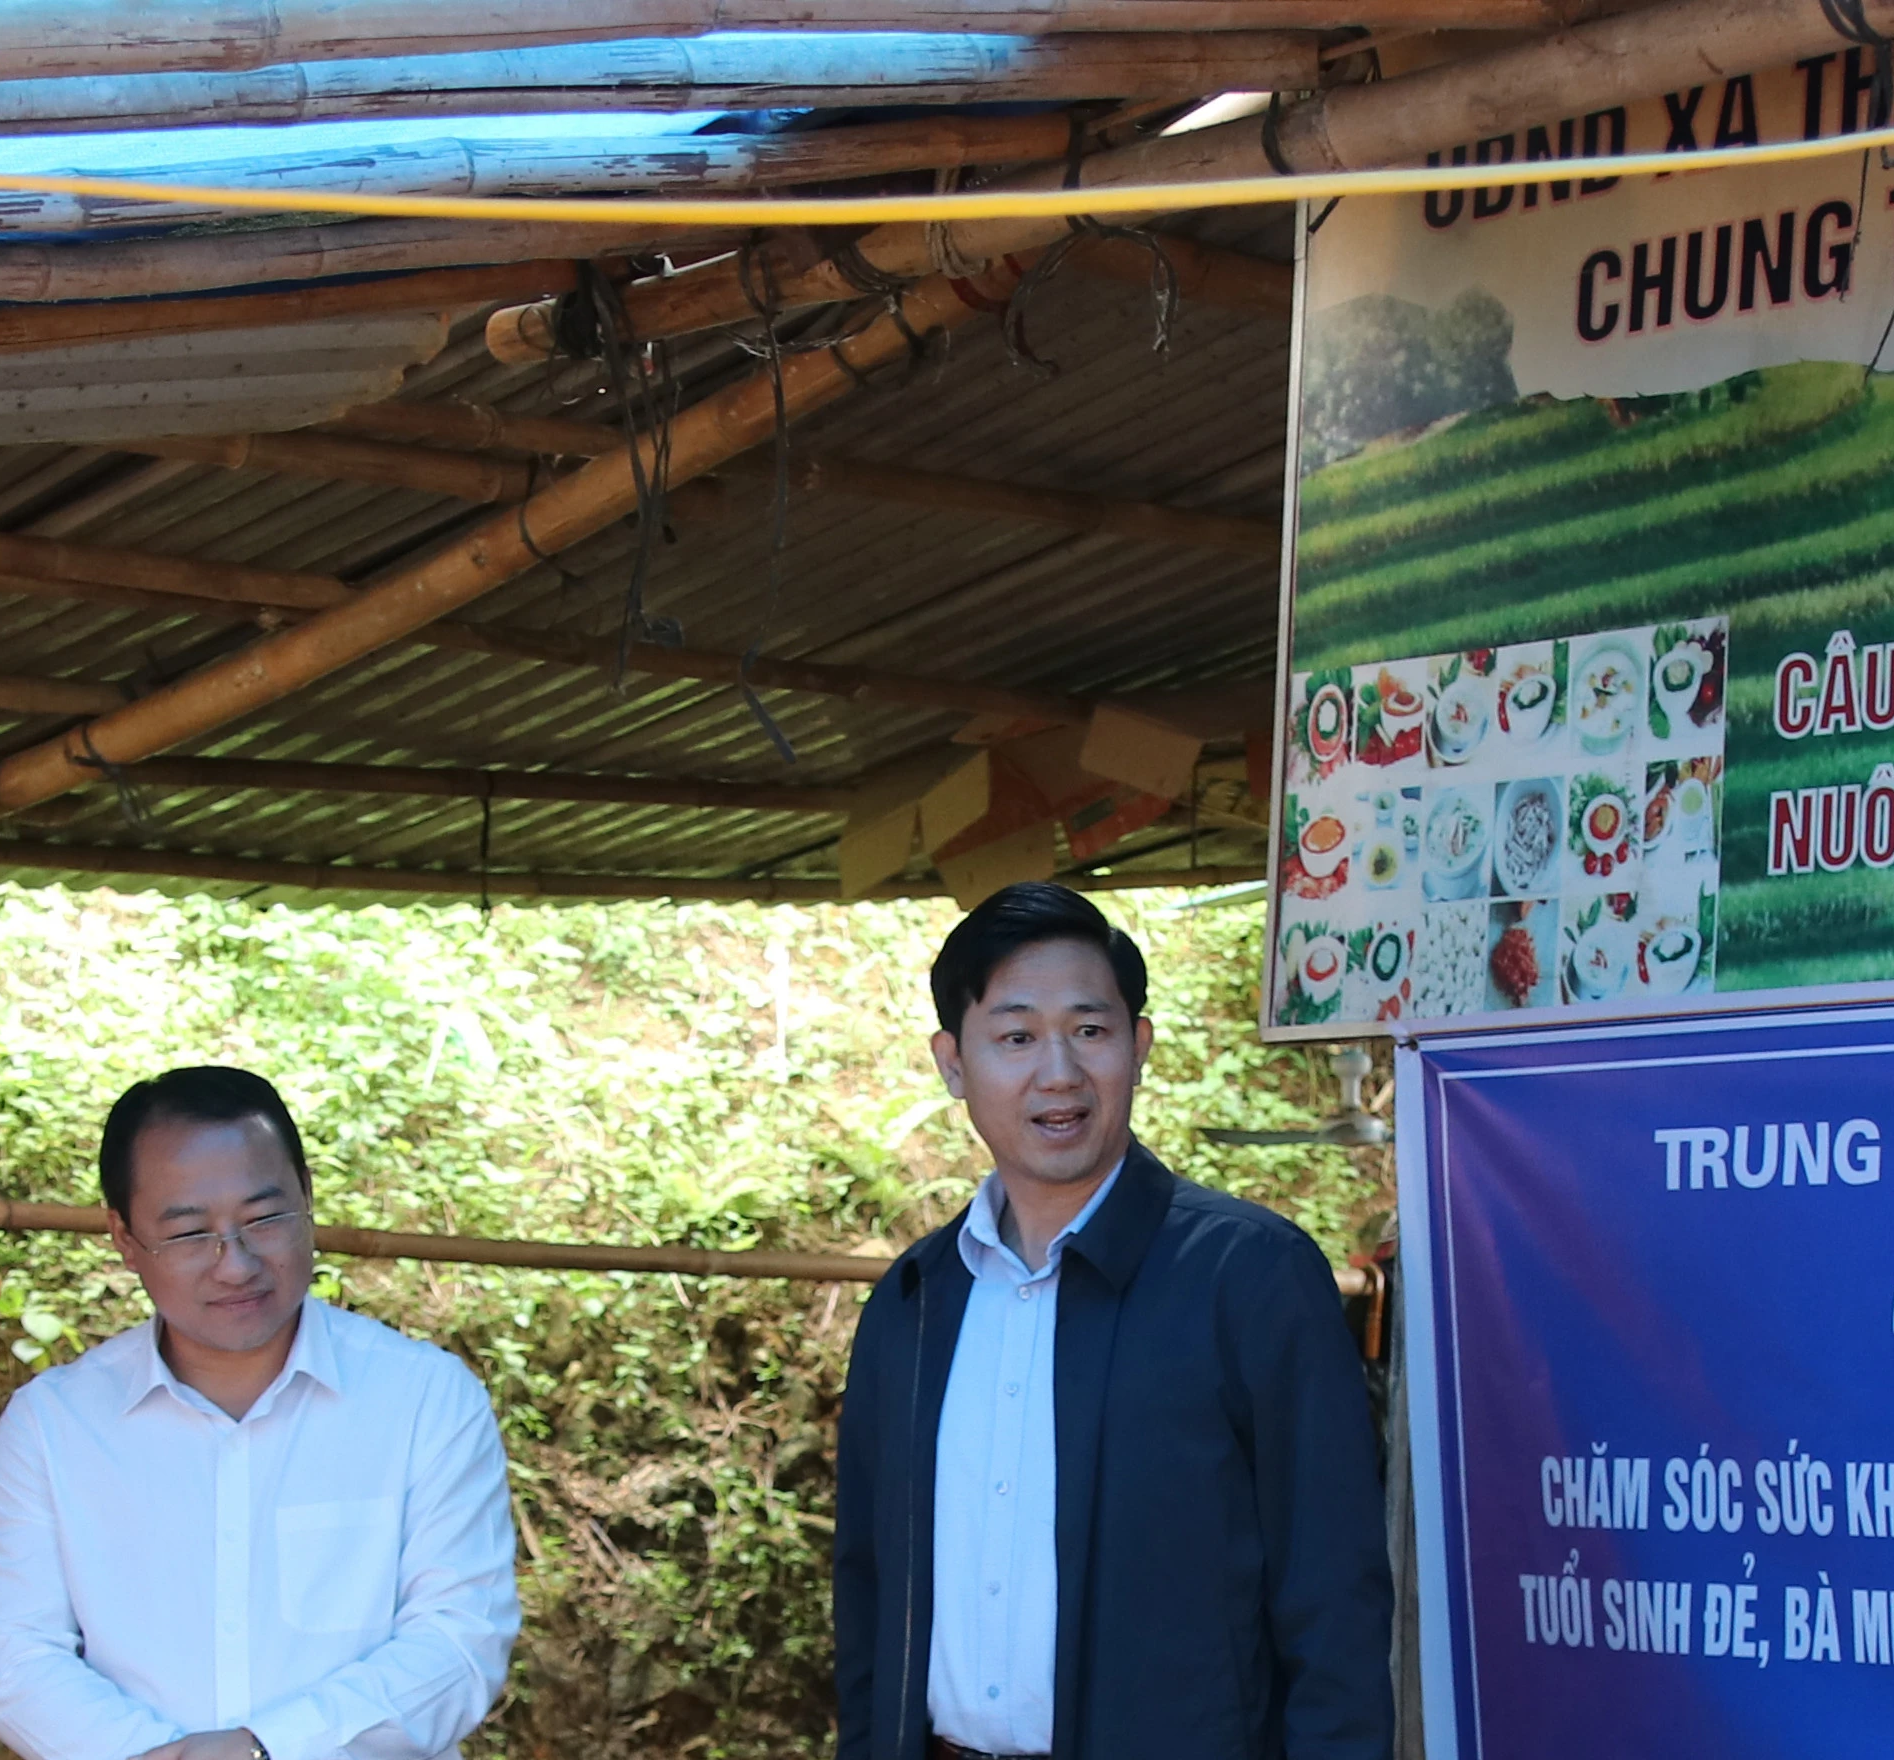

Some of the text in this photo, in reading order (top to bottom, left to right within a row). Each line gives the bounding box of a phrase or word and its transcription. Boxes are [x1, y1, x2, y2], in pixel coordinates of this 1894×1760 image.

[1577, 200, 1854, 342] CHUNG
[1654, 1117, 1882, 1191] TRUNG
[1540, 1441, 1650, 1531] CHĂM
[1663, 1442, 1743, 1534] SÓC
[1755, 1438, 1834, 1537] SỨC
[1519, 1548, 1595, 1648] TUỔI
[1603, 1579, 1692, 1656] SINH
[1703, 1552, 1770, 1668] ĐẺ,
[1784, 1571, 1841, 1663] BÀ
